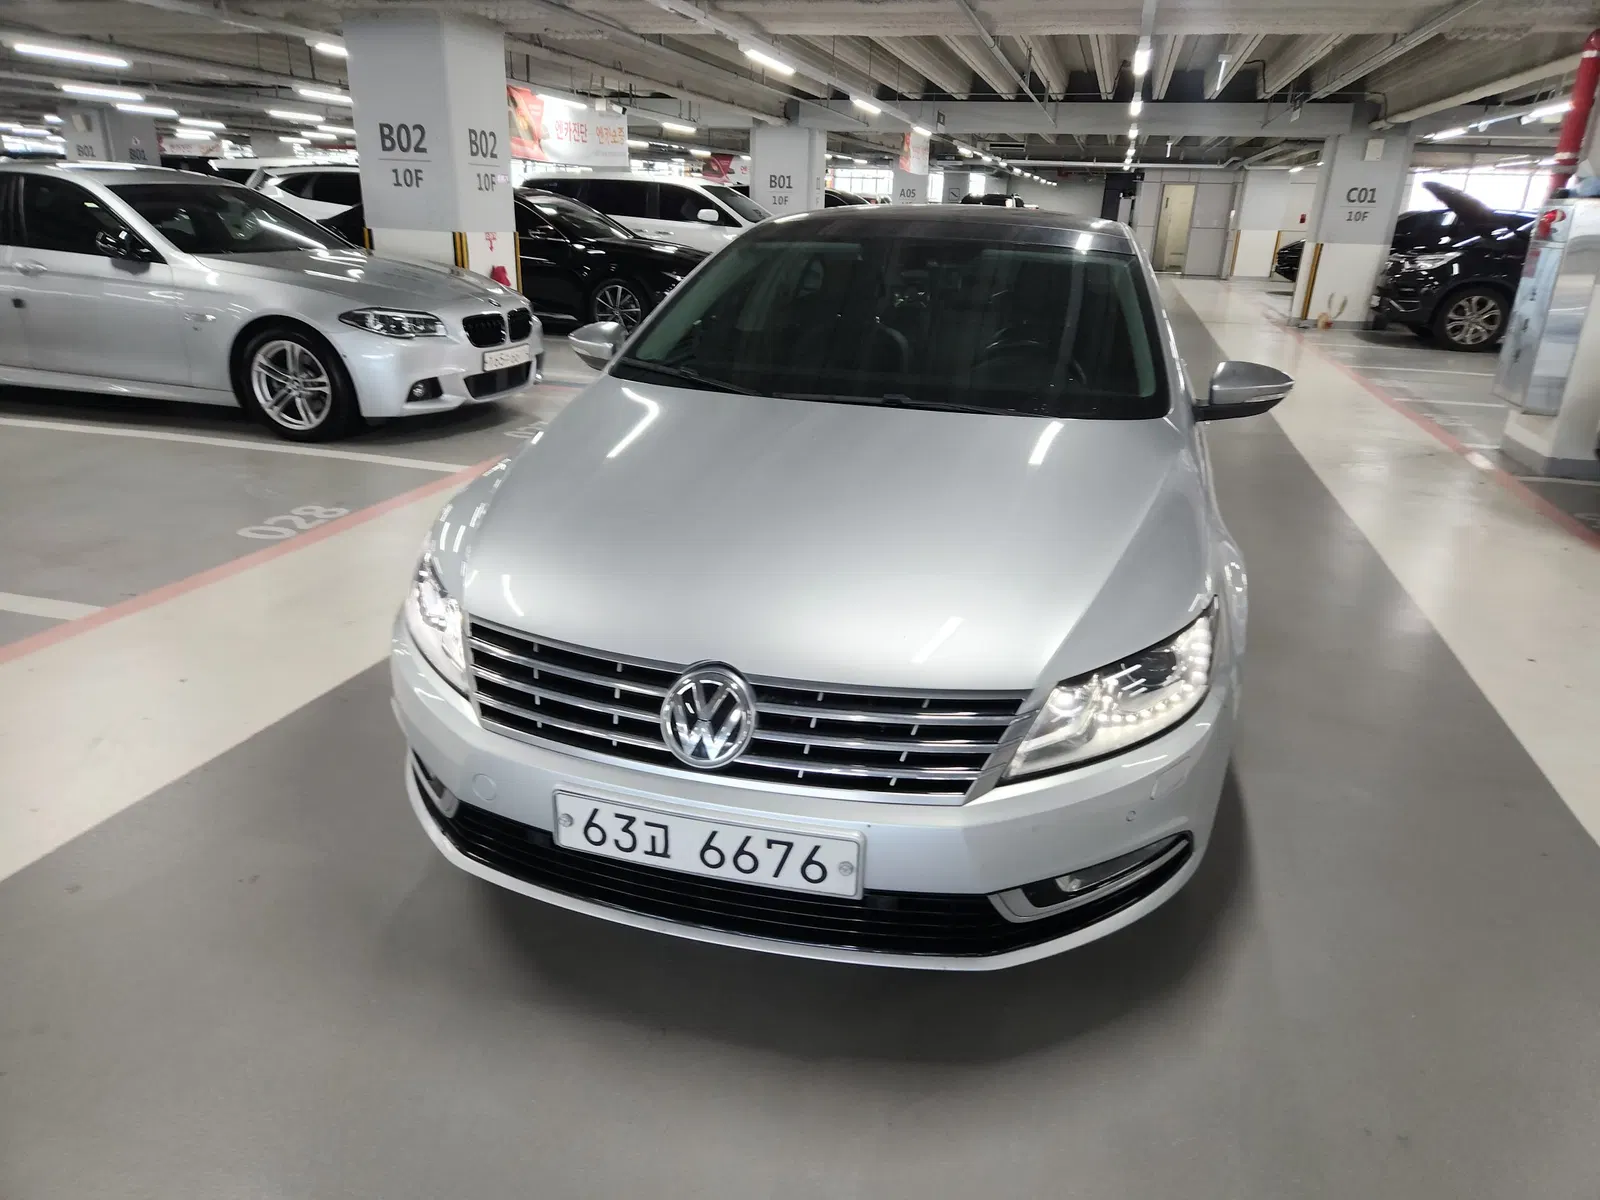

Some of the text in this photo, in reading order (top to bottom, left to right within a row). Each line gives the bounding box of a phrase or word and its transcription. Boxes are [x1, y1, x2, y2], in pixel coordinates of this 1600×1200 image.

[379, 122, 428, 154] B02
[555, 120, 588, 143] 엔카진단
[468, 128, 498, 159] B02
[392, 168, 424, 188] 10F
[477, 172, 496, 192] 10F
[769, 174, 793, 189] B01
[772, 196, 788, 205] 10F
[899, 188, 916, 198] A05
[1346, 187, 1377, 204] C01
[1346, 211, 1369, 222] 10F
[236, 505, 350, 541] 028
[668, 674, 748, 764] VW
[583, 808, 828, 885] 63고 6676
